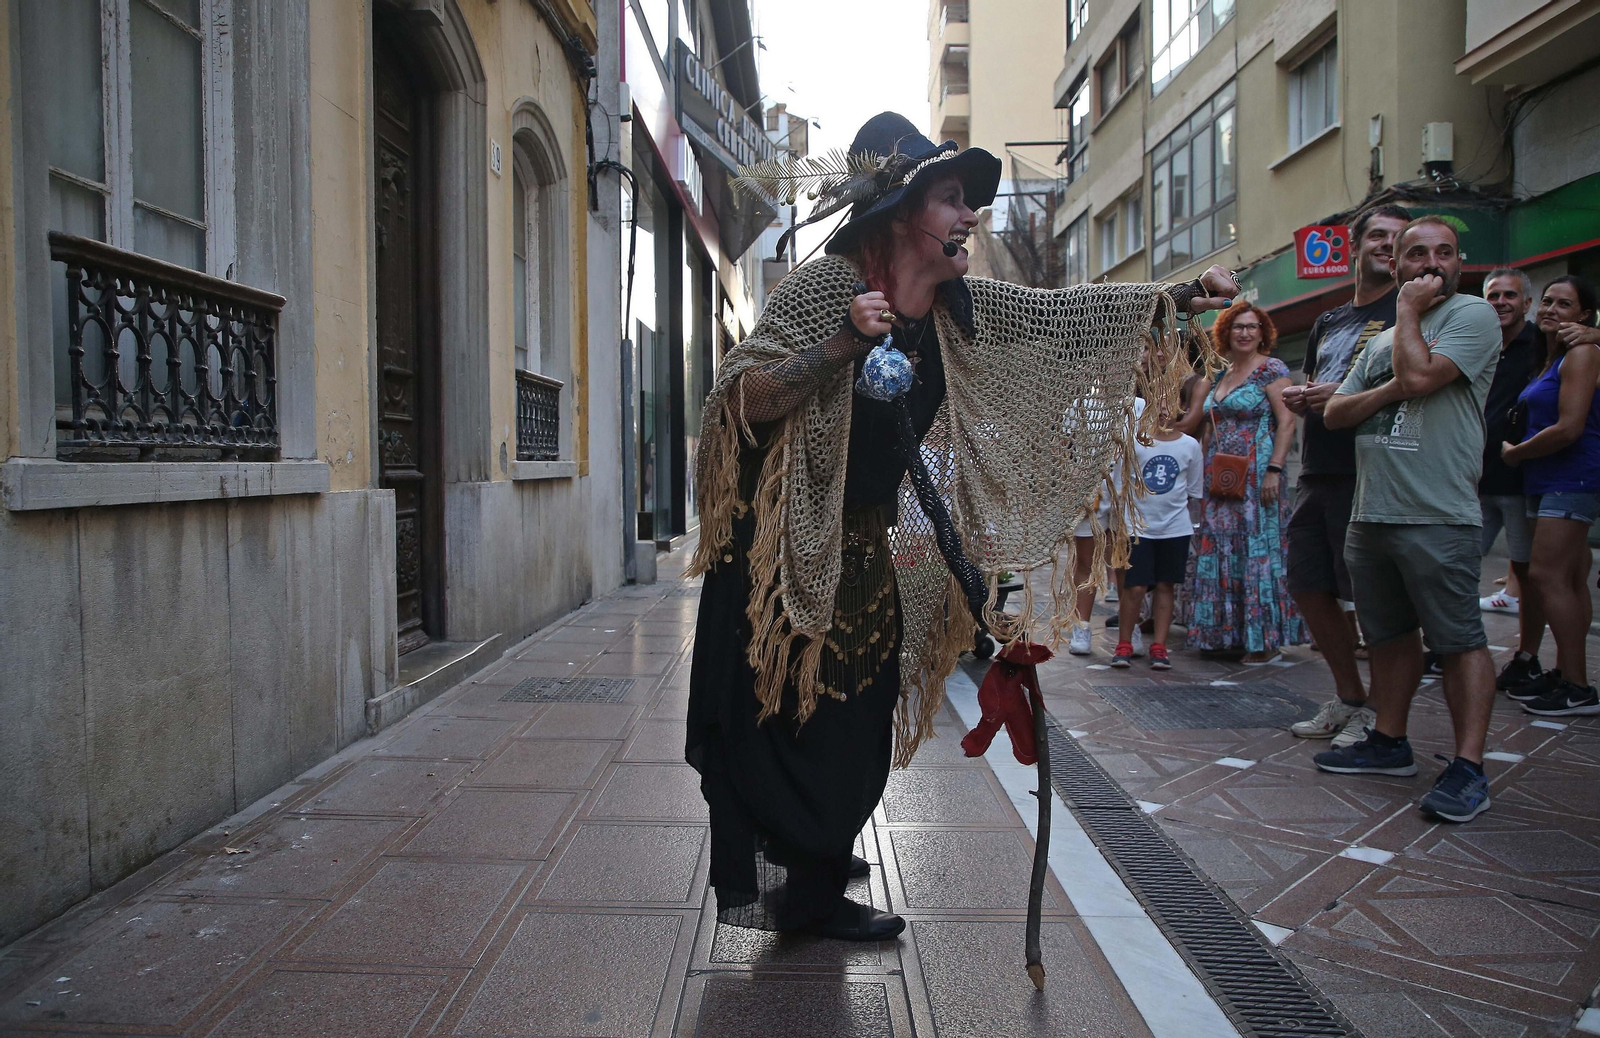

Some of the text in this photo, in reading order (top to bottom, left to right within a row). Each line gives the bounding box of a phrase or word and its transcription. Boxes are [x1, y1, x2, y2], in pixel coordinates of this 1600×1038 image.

[685, 53, 736, 126] CLINICA
[1303, 265, 1349, 275] EURO 6000
